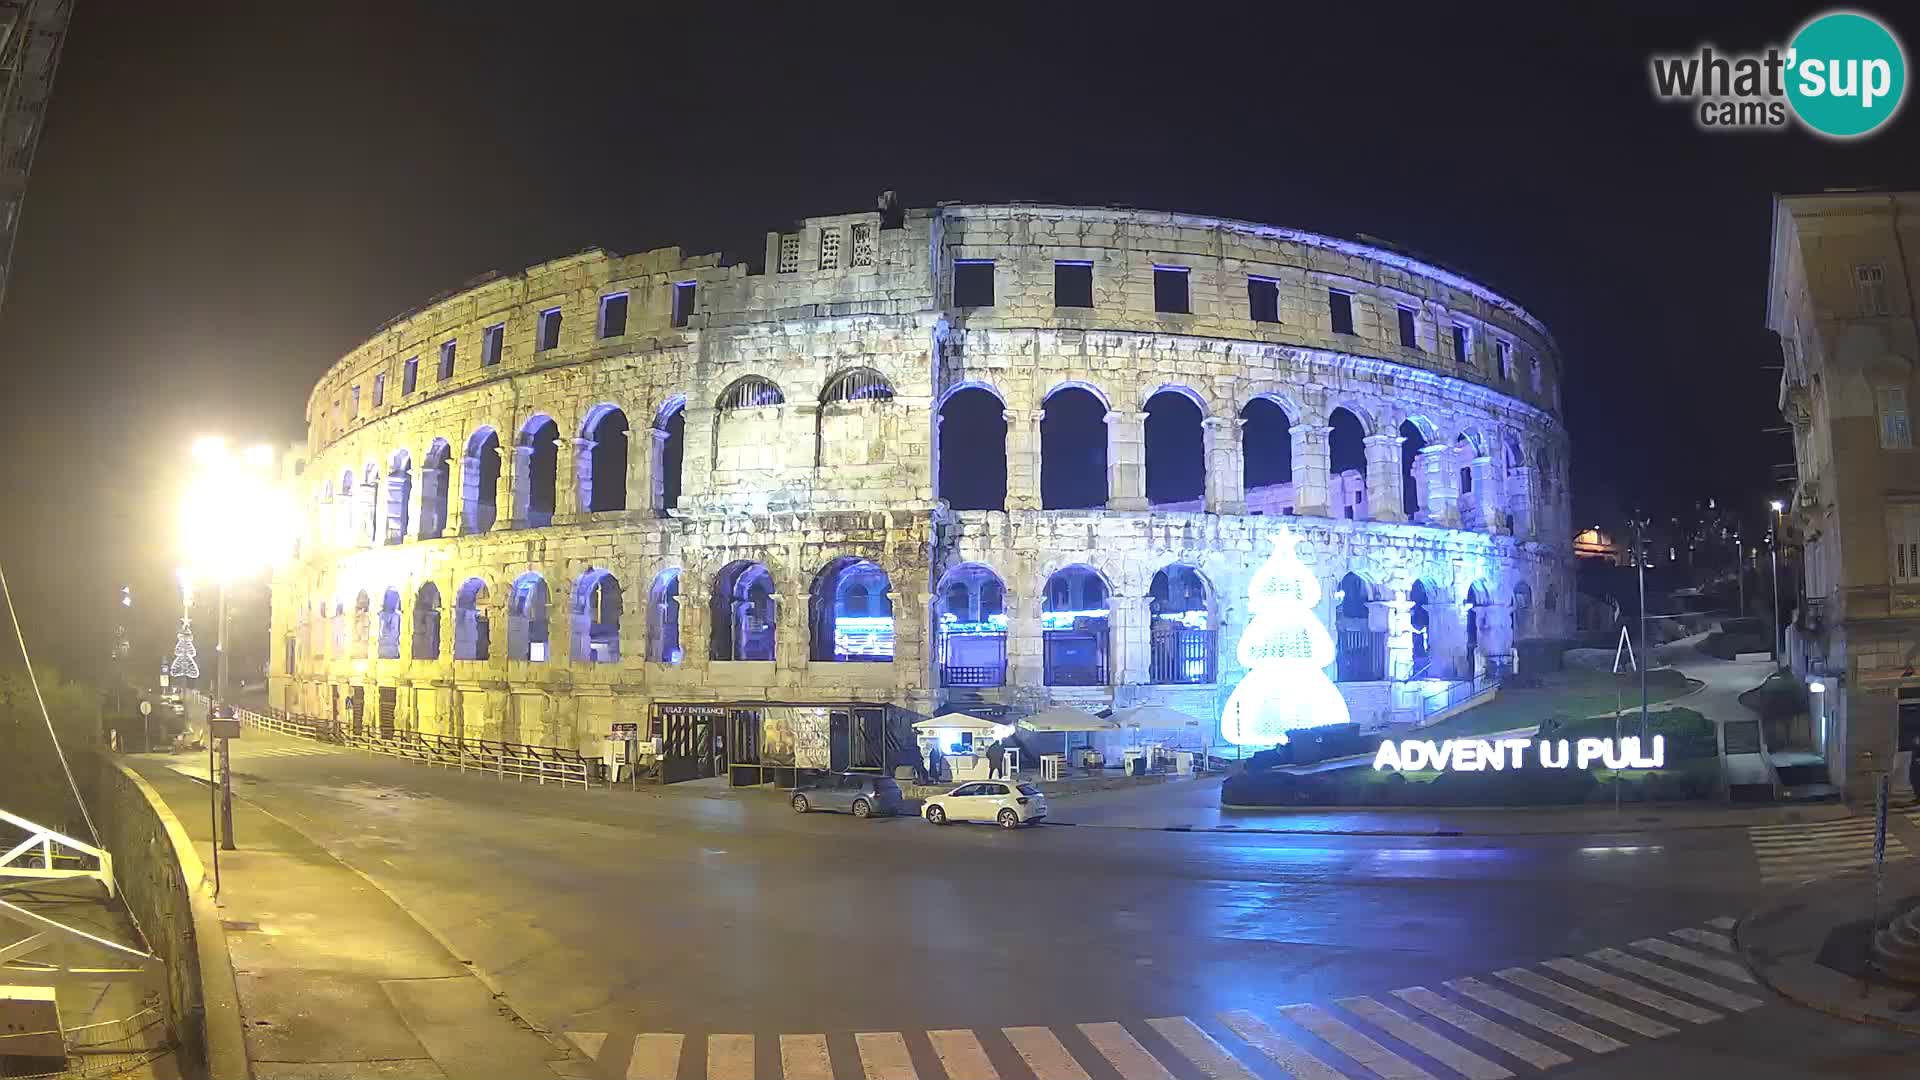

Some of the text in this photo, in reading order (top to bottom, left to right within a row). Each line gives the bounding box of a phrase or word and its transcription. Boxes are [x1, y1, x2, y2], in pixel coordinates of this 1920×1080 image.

[665, 706, 683, 714] ULAZ
[688, 706, 725, 715] ENTRANCE
[1372, 734, 1665, 771] ADVENT U PULI
